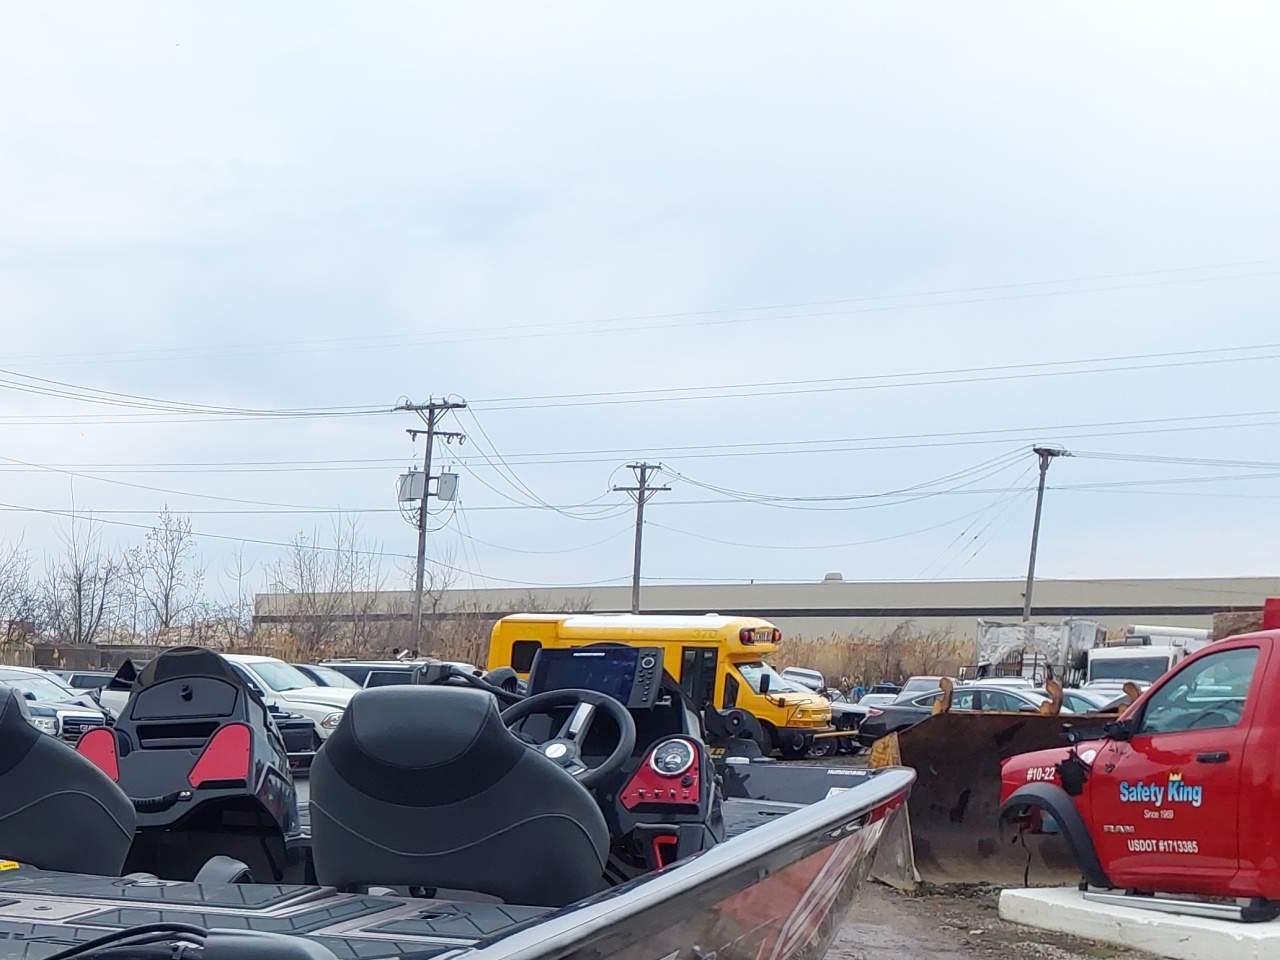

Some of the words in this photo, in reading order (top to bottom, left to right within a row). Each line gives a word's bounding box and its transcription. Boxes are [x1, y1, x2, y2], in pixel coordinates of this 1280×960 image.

[1027, 767, 1056, 781] #10-22
[1120, 781, 1164, 807] Safety
[1167, 780, 1203, 807] King
[1128, 839, 1157, 852] USDOT
